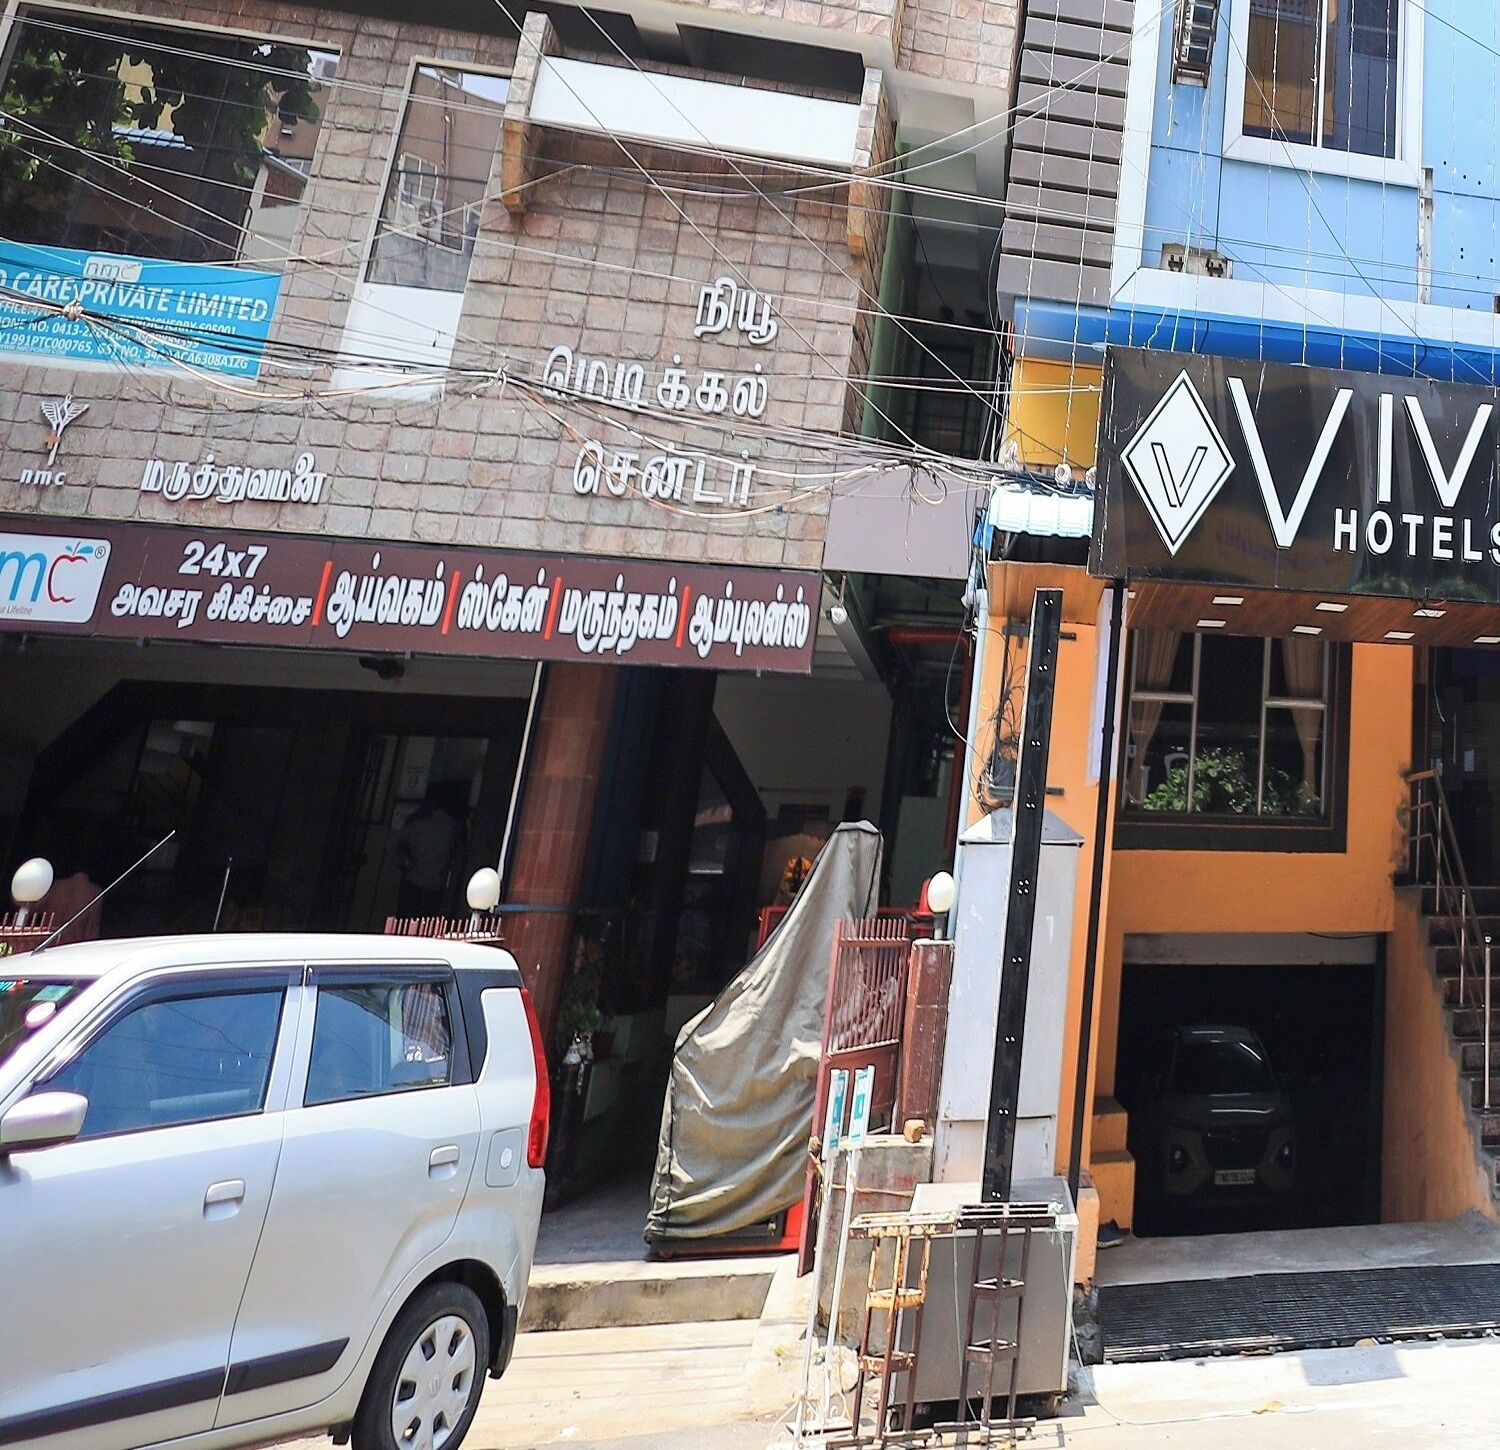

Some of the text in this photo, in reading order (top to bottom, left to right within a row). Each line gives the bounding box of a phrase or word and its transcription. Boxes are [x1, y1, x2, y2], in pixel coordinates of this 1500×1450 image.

[12, 272, 75, 301] CARE
[79, 281, 173, 312] PRIVATE
[176, 290, 269, 322] LIMITED
[693, 276, 779, 344] நியூ
[20, 468, 66, 486] nmc
[140, 453, 327, 504] மருத்துவமனை
[179, 540, 268, 578] 24x7
[111, 581, 313, 629] அவசர சிகிச்சை
[326, 553, 811, 658] ஆய்வகம் ஸ்கேன் மருந்தகம் ஆம்புலன்ஸ்
